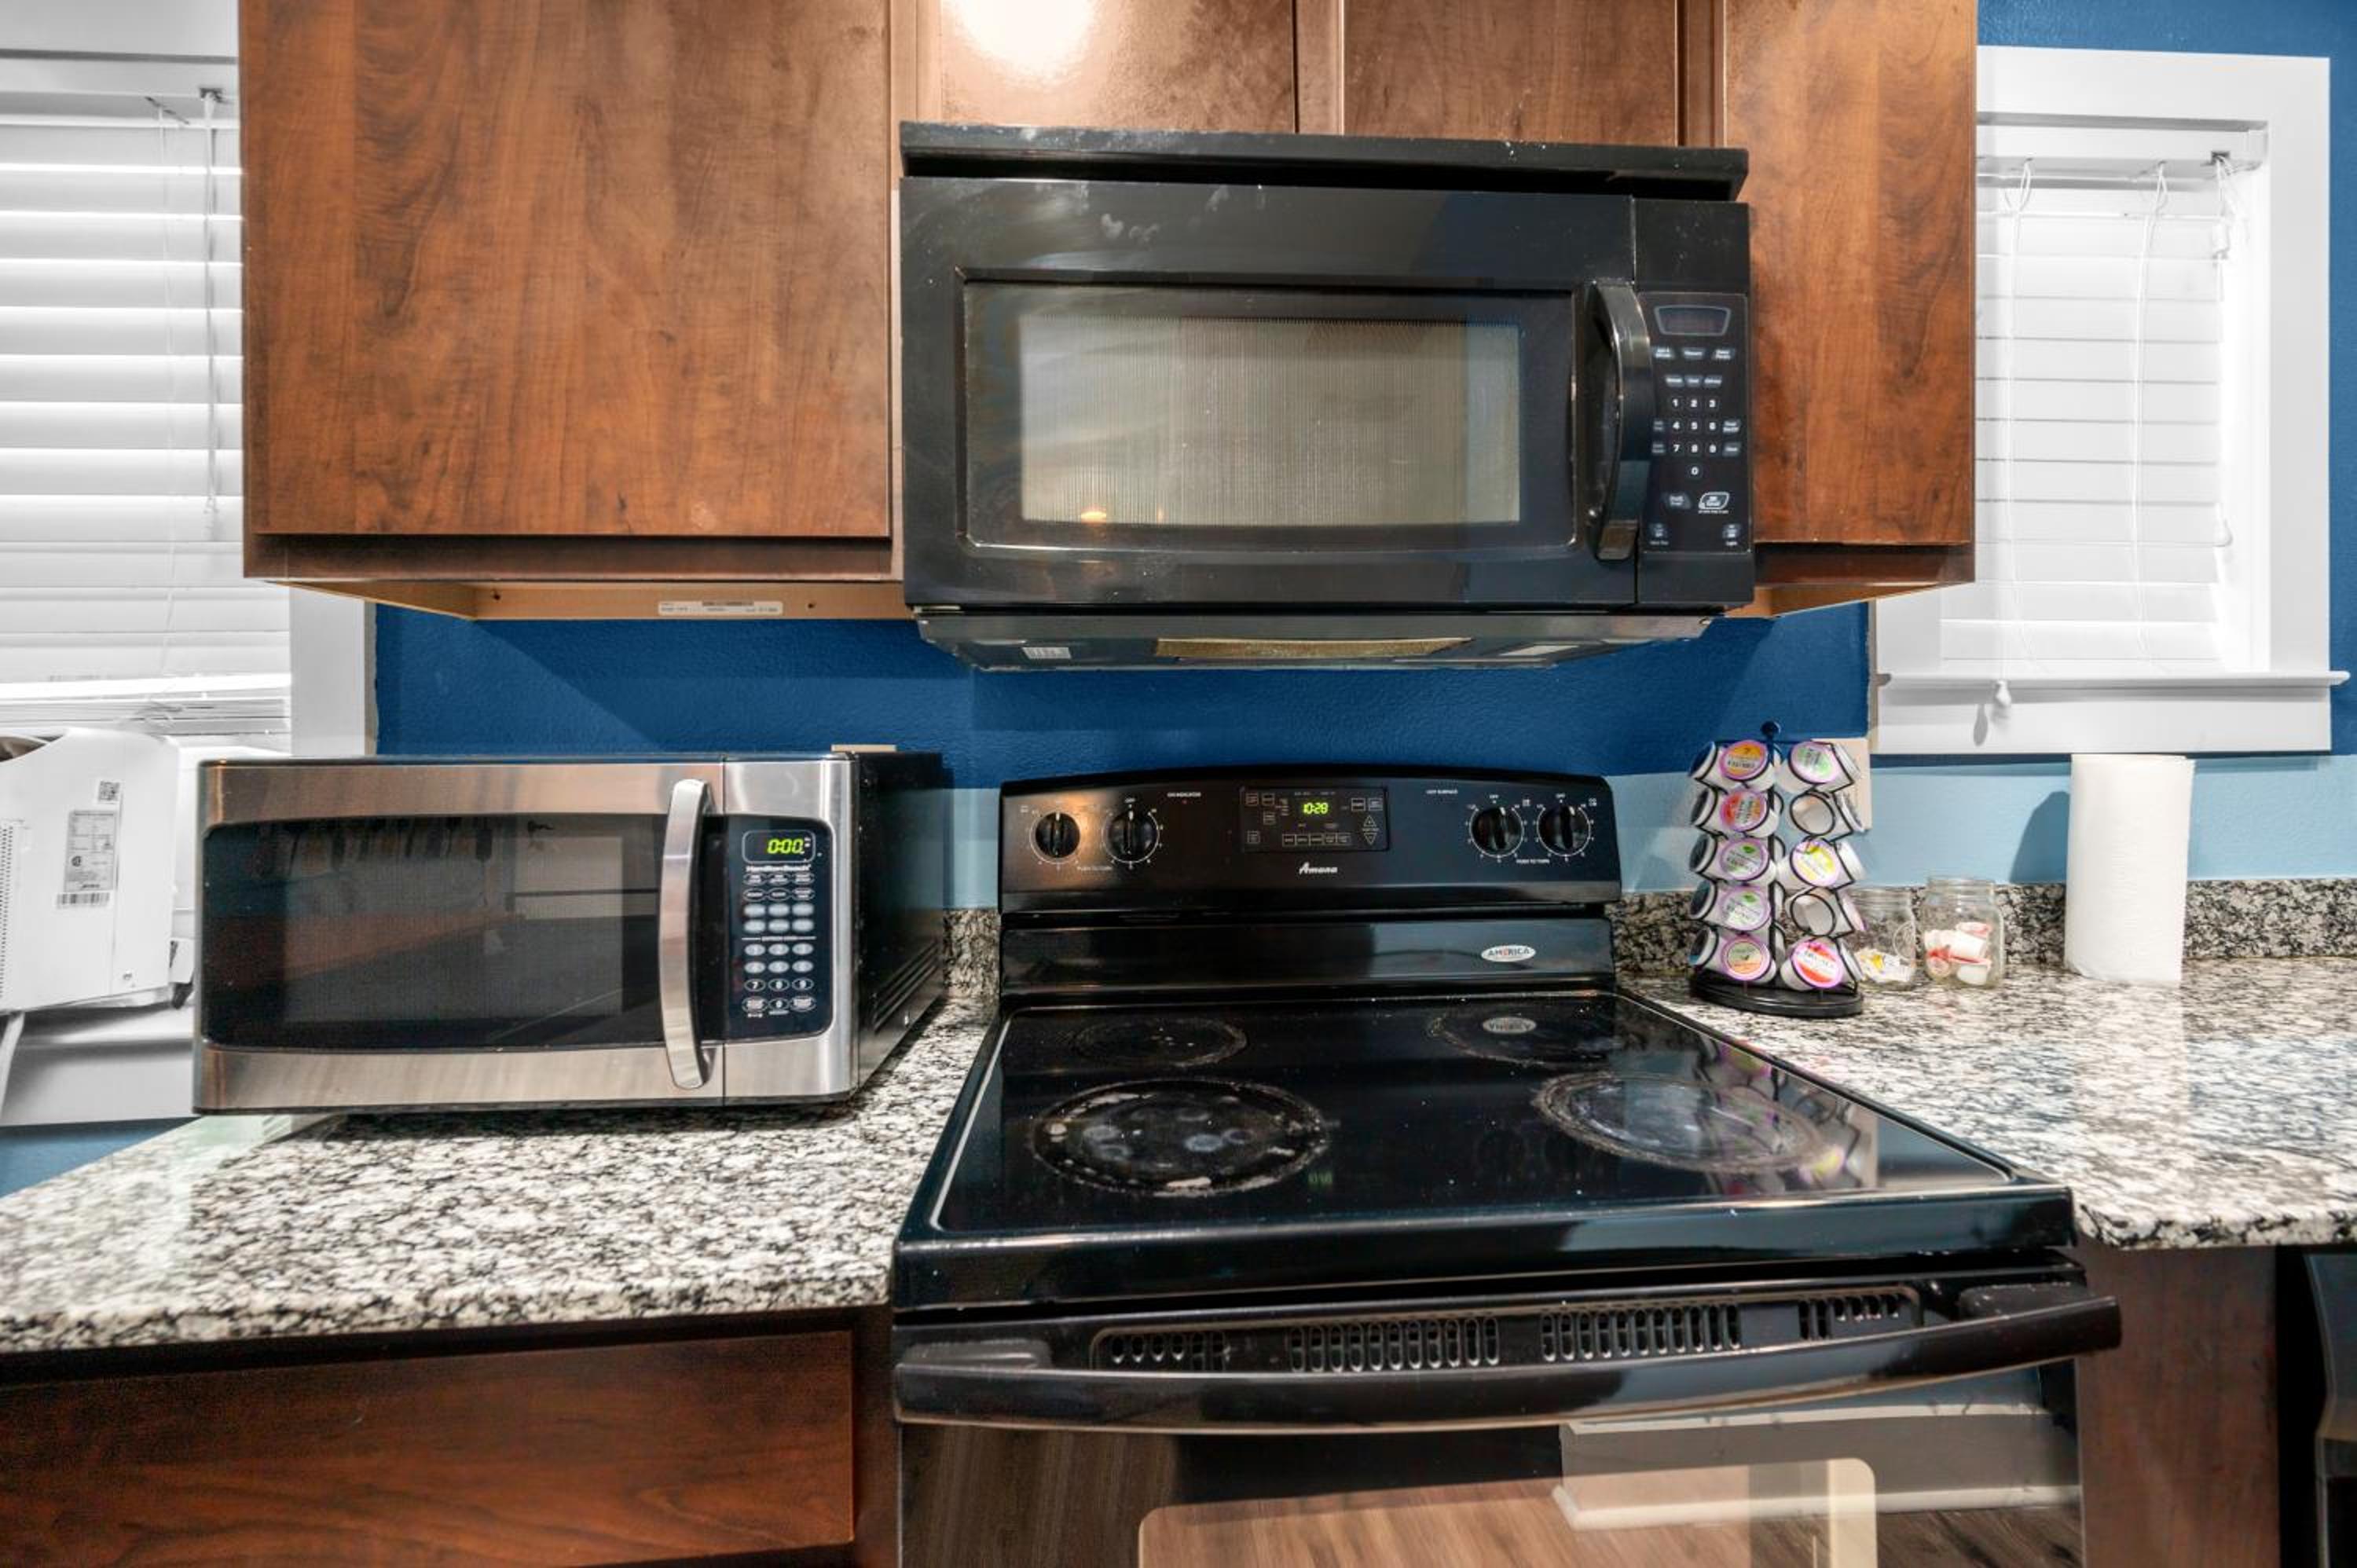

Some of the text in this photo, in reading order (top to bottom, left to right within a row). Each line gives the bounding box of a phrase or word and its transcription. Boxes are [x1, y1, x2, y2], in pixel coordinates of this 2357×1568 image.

[1672, 398, 1678, 407] 1
[1690, 399, 1697, 408] 2
[1673, 421, 1680, 430] 4
[1673, 444, 1680, 452] 7
[1691, 466, 1699, 475] 0
[1299, 862, 1338, 875] Amana
[1487, 947, 1531, 956] AMERICA
